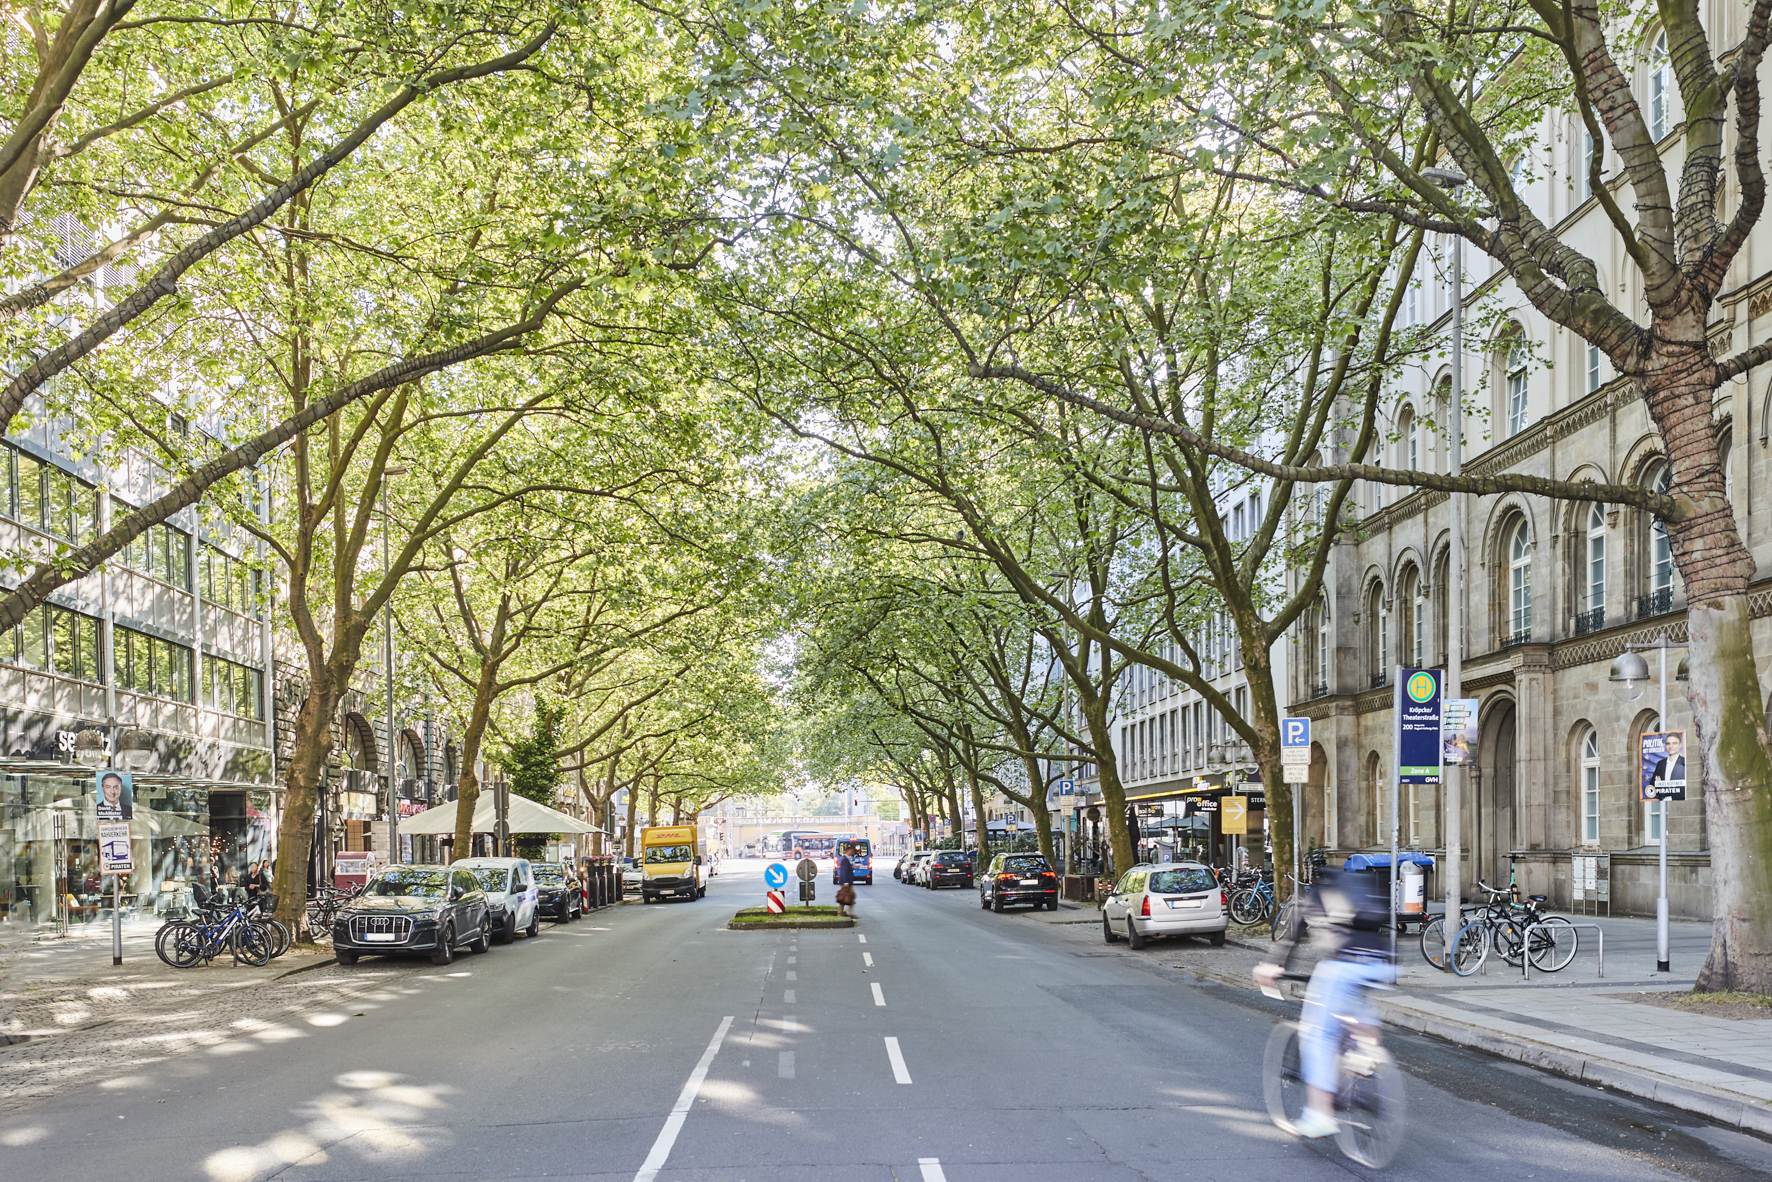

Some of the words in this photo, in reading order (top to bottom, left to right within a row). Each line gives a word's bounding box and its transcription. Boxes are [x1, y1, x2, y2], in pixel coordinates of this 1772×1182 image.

[1409, 706, 1433, 714] Kröpcke/
[1288, 721, 1304, 744] P
[1062, 782, 1071, 794] P
[1187, 796, 1198, 804] pro
[1197, 800, 1218, 808] office
